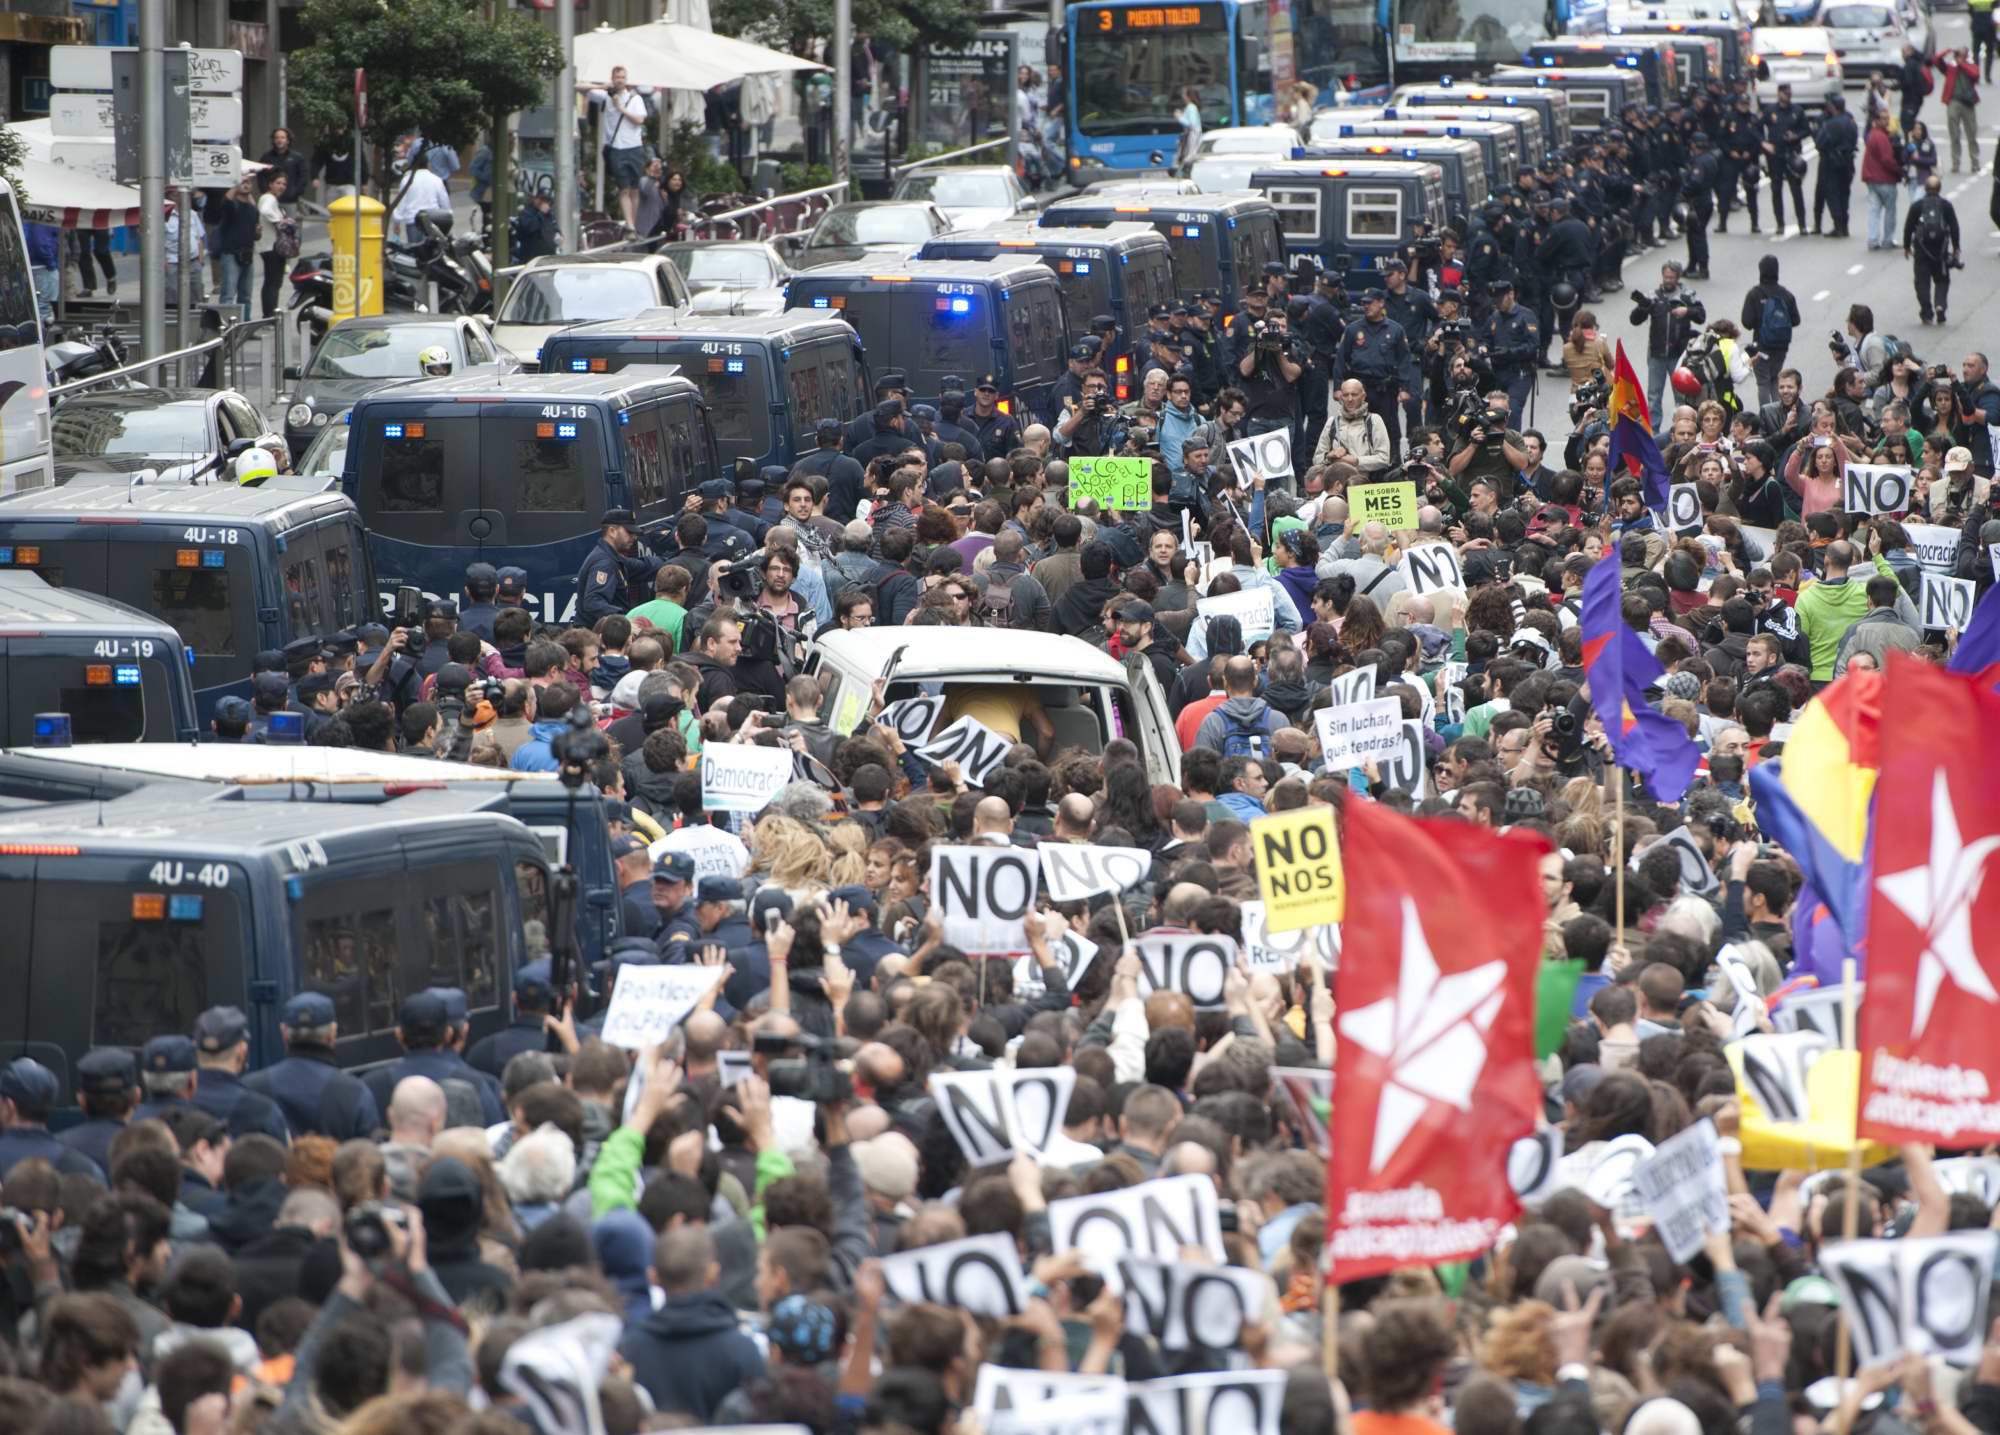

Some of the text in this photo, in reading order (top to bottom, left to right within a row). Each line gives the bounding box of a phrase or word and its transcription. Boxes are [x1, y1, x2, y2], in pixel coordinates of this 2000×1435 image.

[1098, 10, 1113, 30] 3
[1176, 212, 1208, 223] 4U-10
[1066, 248, 1101, 259] 4U-12
[937, 284, 974, 295] 4U-13
[701, 342, 742, 355] 4U-15
[541, 405, 587, 418] 4U-16
[1232, 434, 1291, 489] NO
[1365, 495, 1402, 511] MES
[1848, 470, 1906, 512] NO
[184, 527, 238, 544] 4U-18
[1407, 546, 1460, 594] NO
[1926, 579, 1970, 628] NO
[94, 639, 154, 658] 4U-19
[1333, 671, 1371, 706] NO
[1329, 713, 1393, 736] Sin luchar,
[1326, 744, 1348, 760] que
[1263, 824, 1327, 868] NO
[150, 861, 229, 887] 4U-40
[939, 855, 1031, 921] NO
[1049, 850, 1143, 896] NO
[1270, 865, 1334, 897] NOS
[1136, 943, 1228, 1006] NO
[945, 1077, 1058, 1159] NO
[1116, 1258, 1246, 1350] NO
[1840, 1249, 1983, 1358] NO
